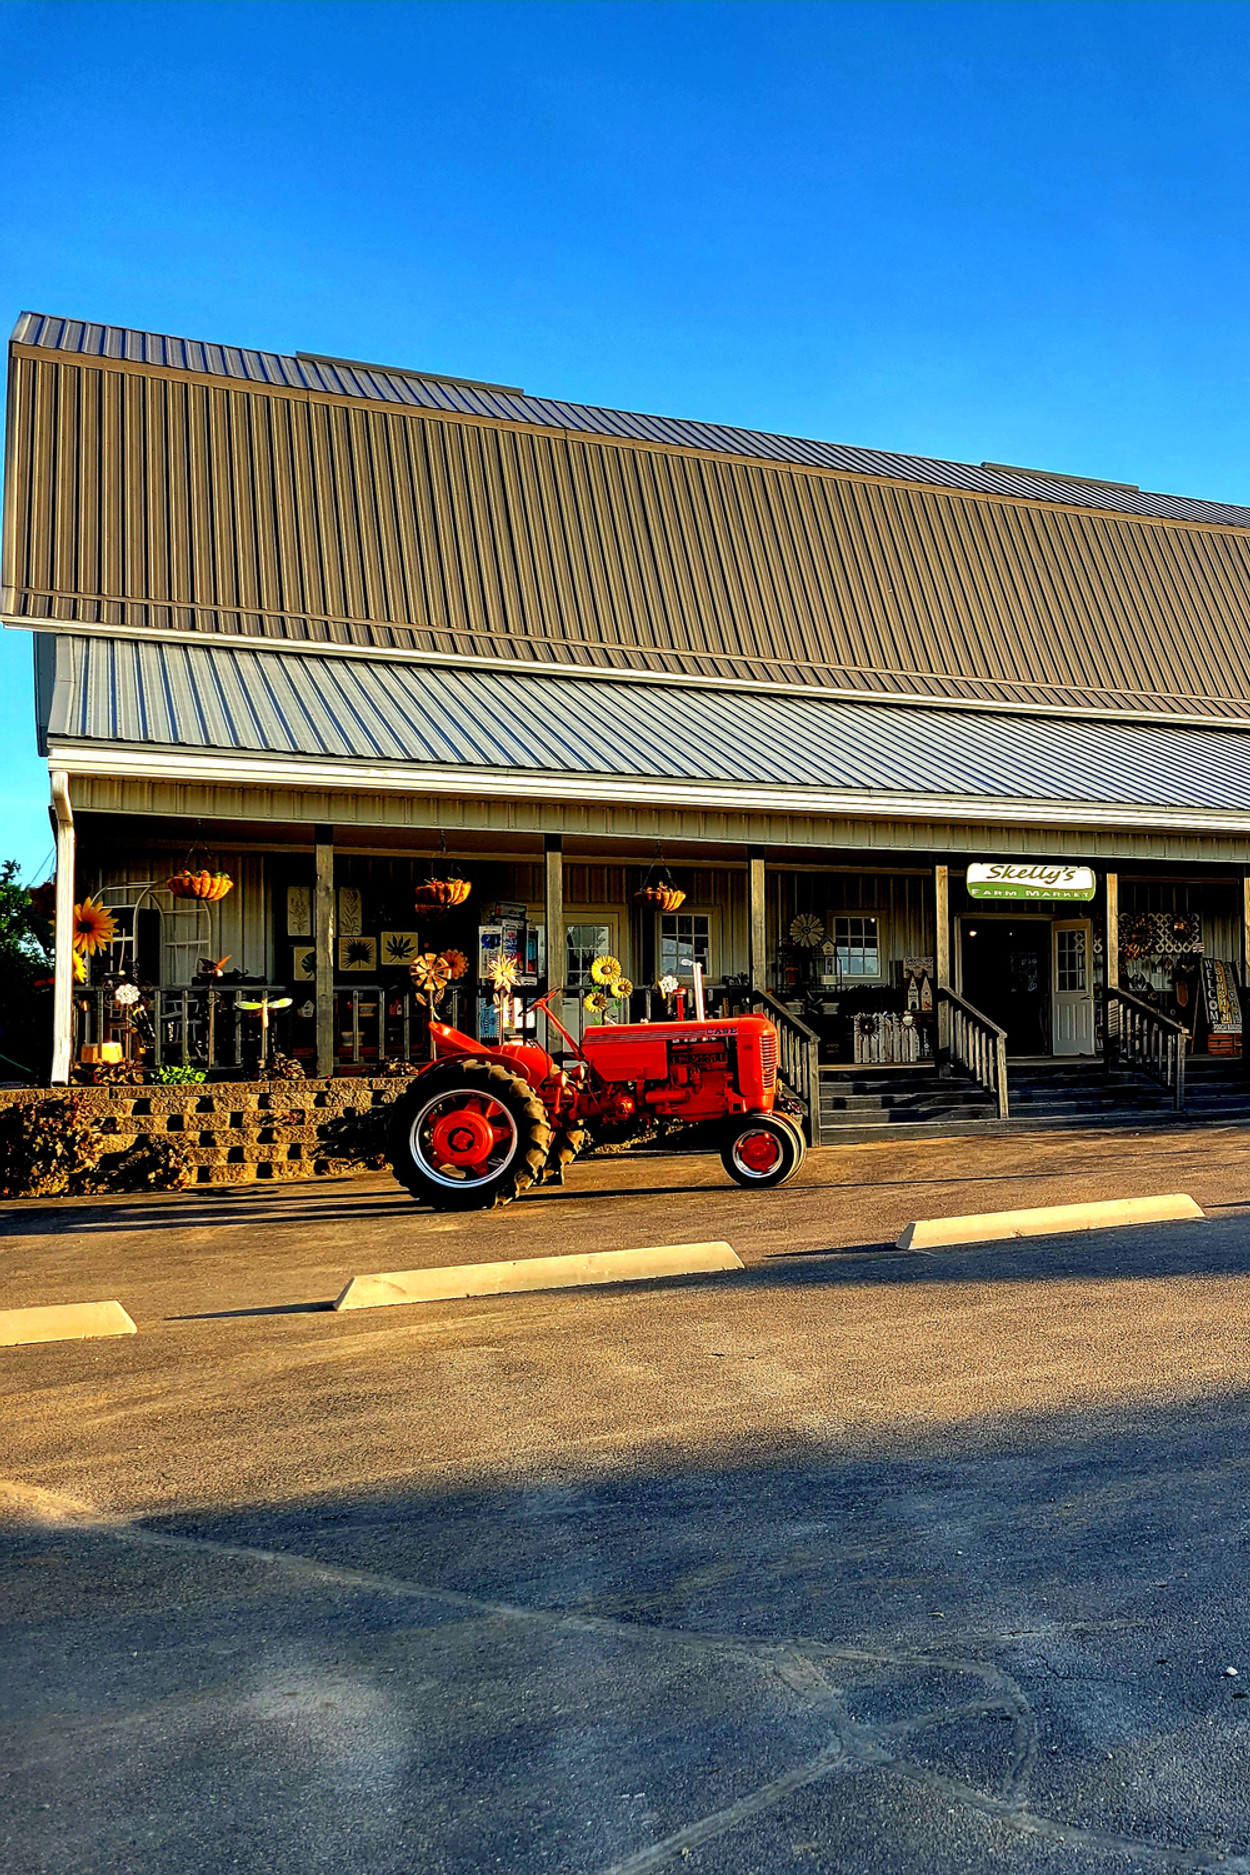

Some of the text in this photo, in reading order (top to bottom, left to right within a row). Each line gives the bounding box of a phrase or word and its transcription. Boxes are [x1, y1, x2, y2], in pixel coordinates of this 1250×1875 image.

[985, 865, 1077, 885] Skelly's
[971, 888, 1090, 898] FARM MARKET
[1204, 959, 1219, 1024] WELCOM
[706, 1027, 738, 1036] CASE
